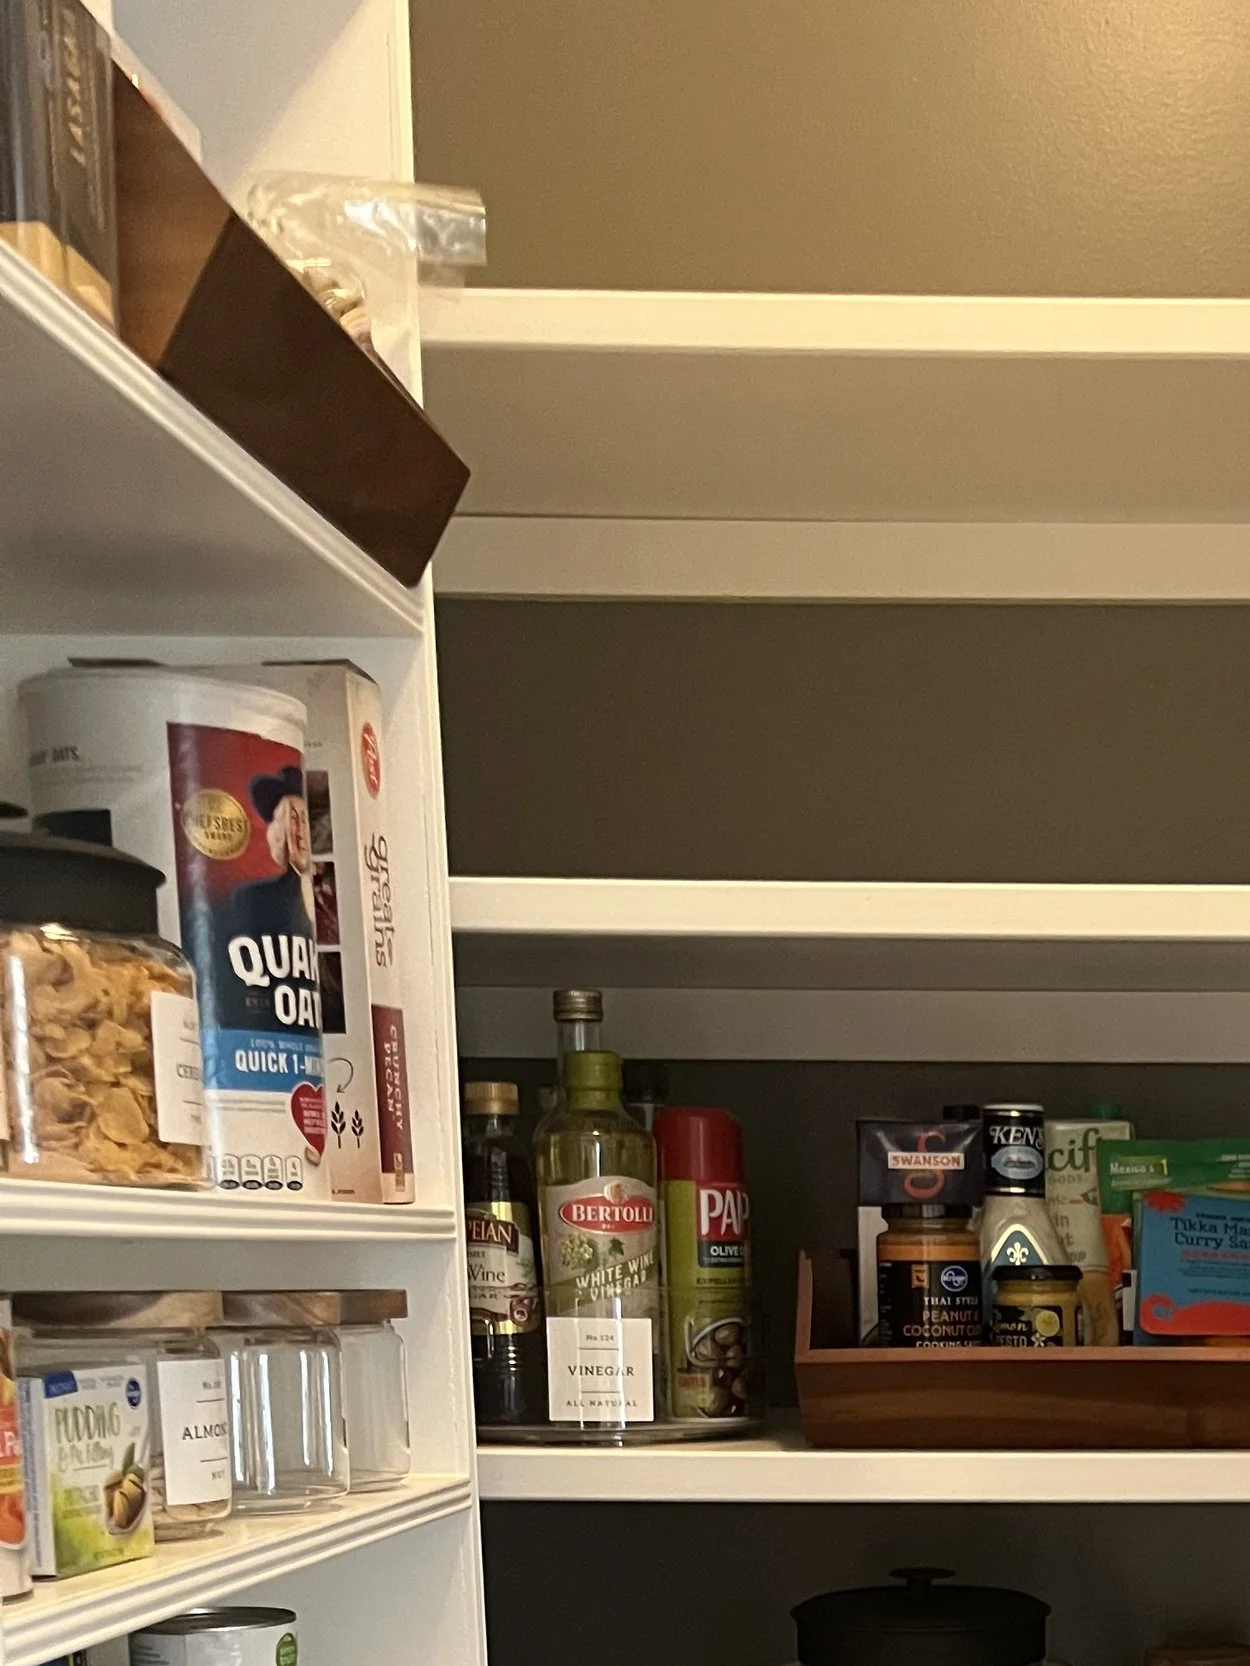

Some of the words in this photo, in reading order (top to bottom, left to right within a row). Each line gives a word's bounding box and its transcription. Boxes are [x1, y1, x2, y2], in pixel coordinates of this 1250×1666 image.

[235, 1049, 289, 1075] QUICK
[383, 1041, 396, 1114] PECAN
[389, 1024, 404, 1132] CRUNCHY
[892, 1155, 961, 1168] SWANSON
[572, 1203, 654, 1223] BERTOLLI
[1168, 1216, 1218, 1234] Tikka
[1174, 1231, 1224, 1251] Curry
[710, 1245, 739, 1257] OLIVE
[576, 1263, 624, 1289] WHITE
[628, 1250, 654, 1273] WINE
[590, 1270, 648, 1301] VINEGAR
[923, 1297, 952, 1306] THAI
[922, 1310, 973, 1323] PEANUT
[902, 1324, 966, 1338] COCONUT
[568, 1365, 635, 1377] VINEGAR
[566, 1399, 586, 1408] ALL
[54, 1401, 121, 1444] PUDDING
